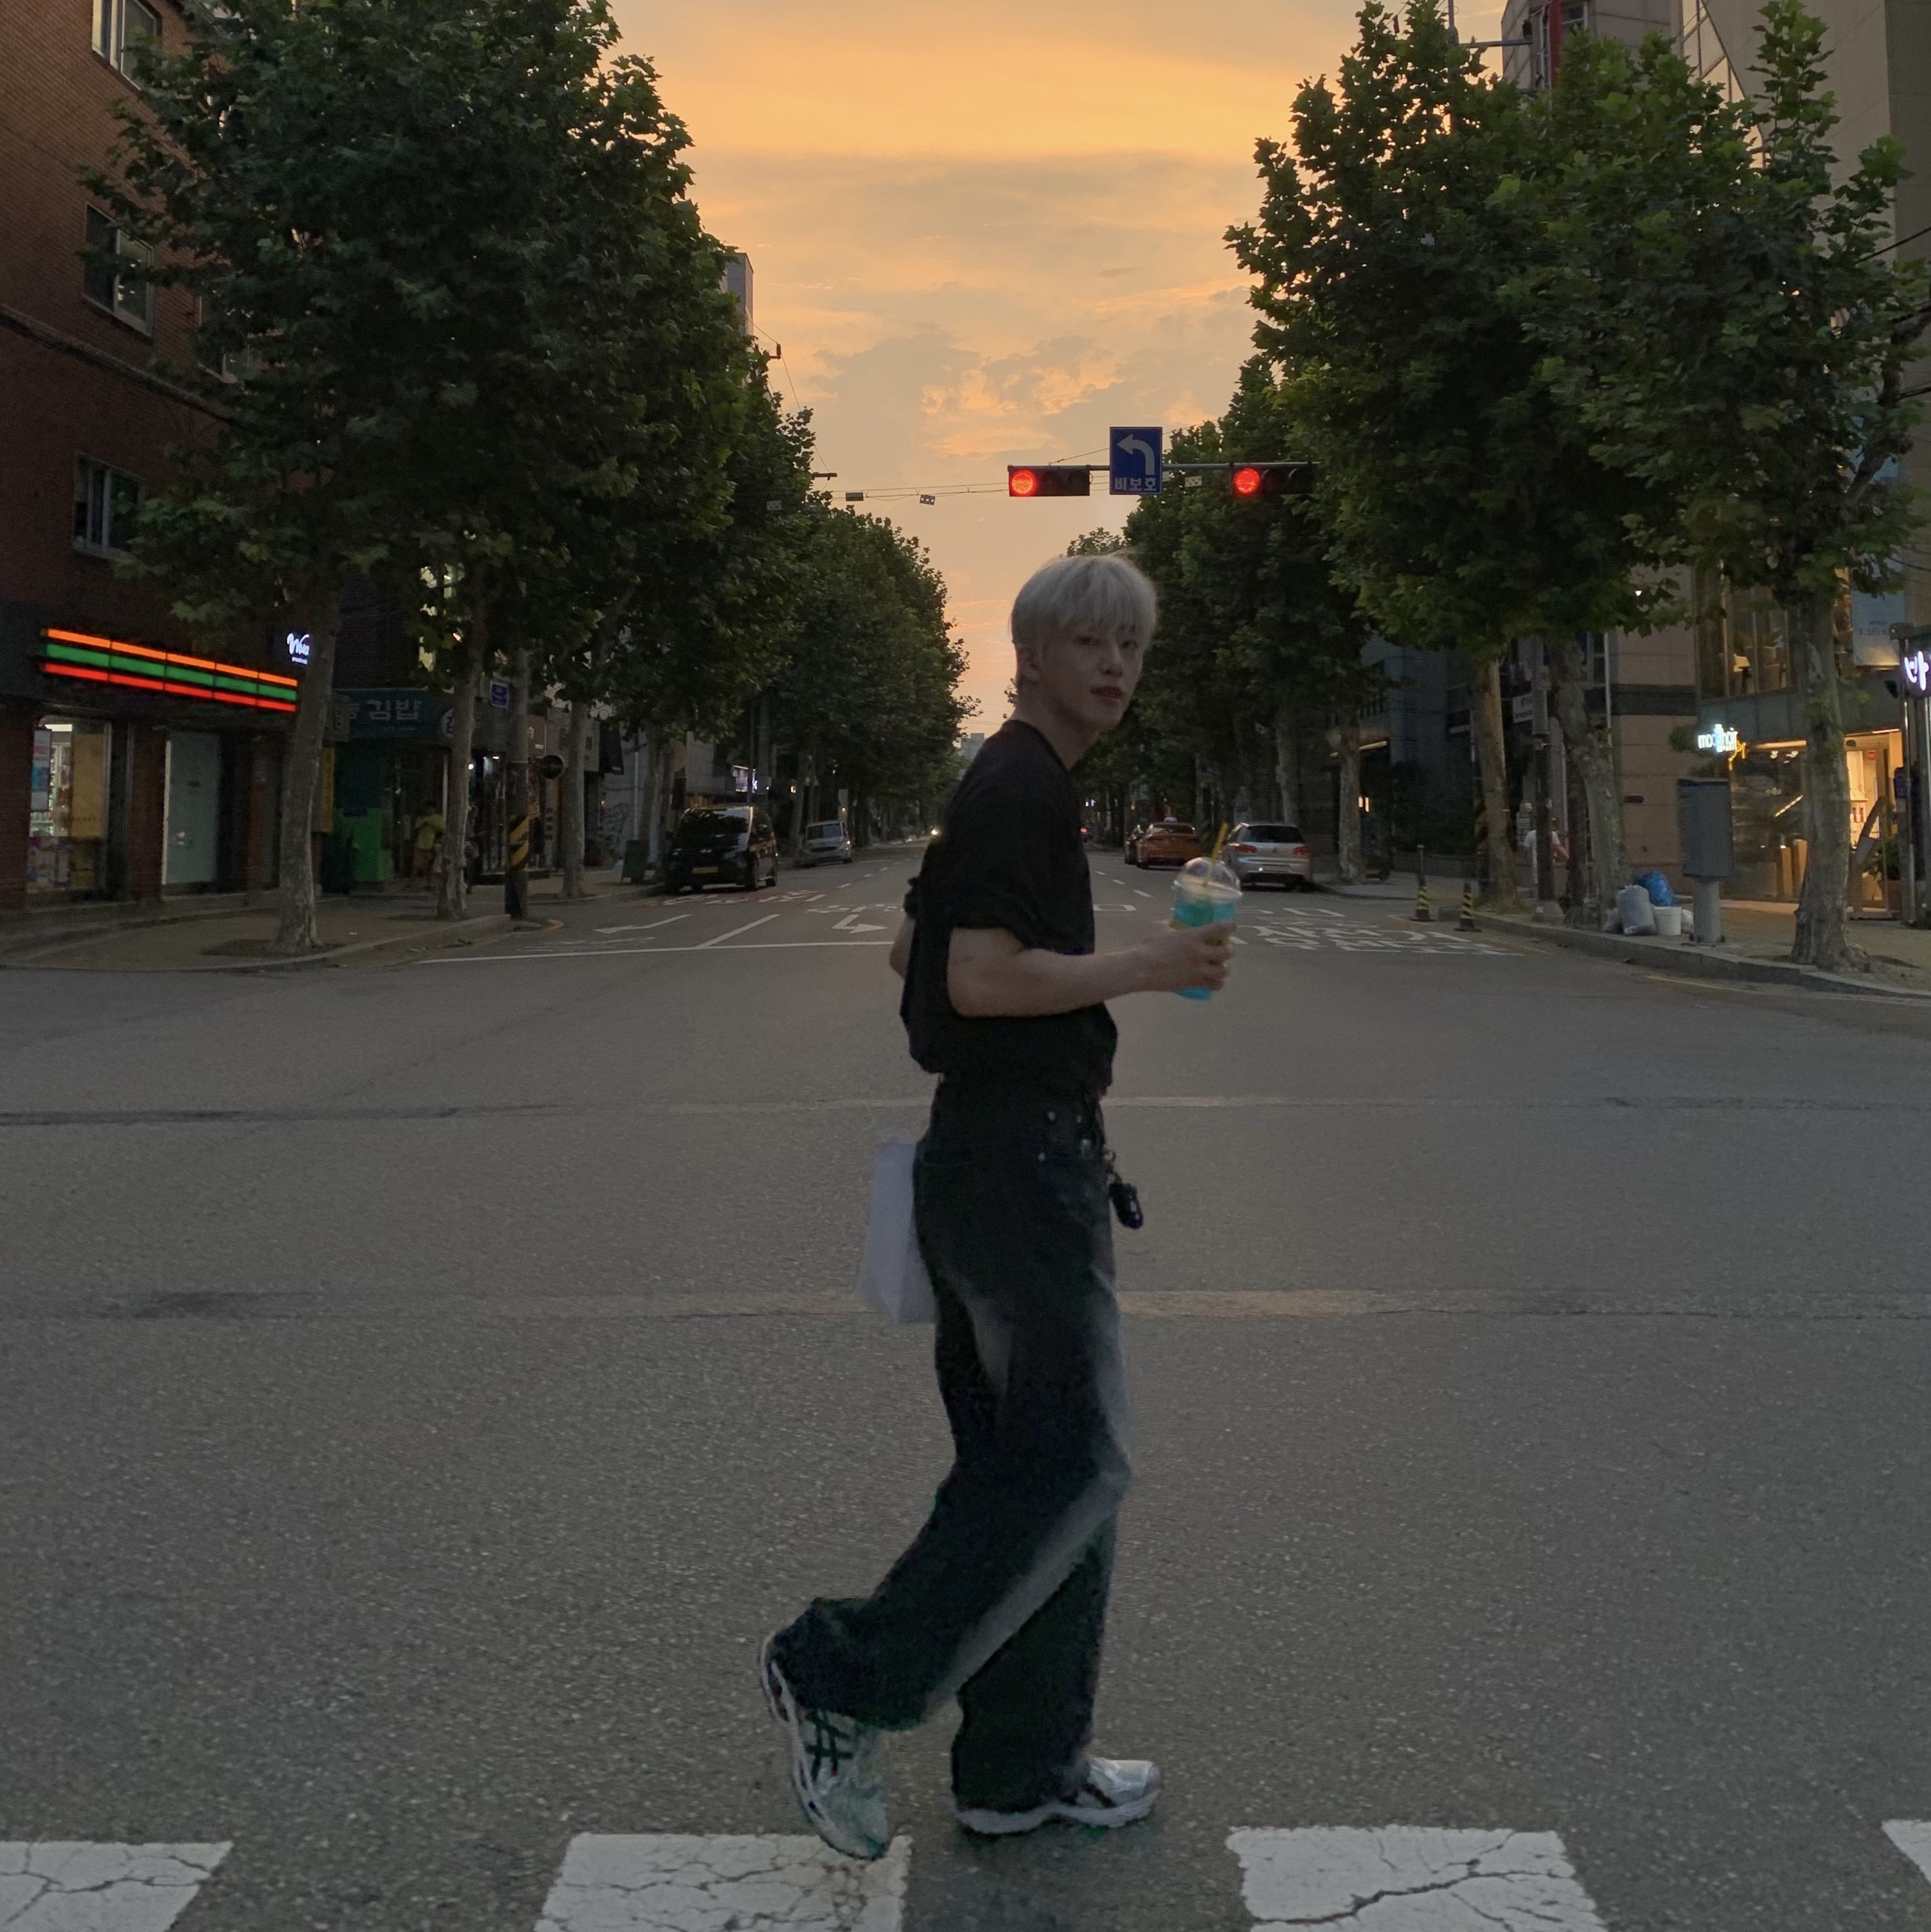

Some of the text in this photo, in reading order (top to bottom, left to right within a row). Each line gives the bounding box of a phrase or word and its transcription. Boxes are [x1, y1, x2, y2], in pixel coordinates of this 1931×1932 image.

[1114, 477, 1157, 491] 비보호
[366, 699, 422, 720] 김밥
[1263, 938, 1525, 956] 우선도로
